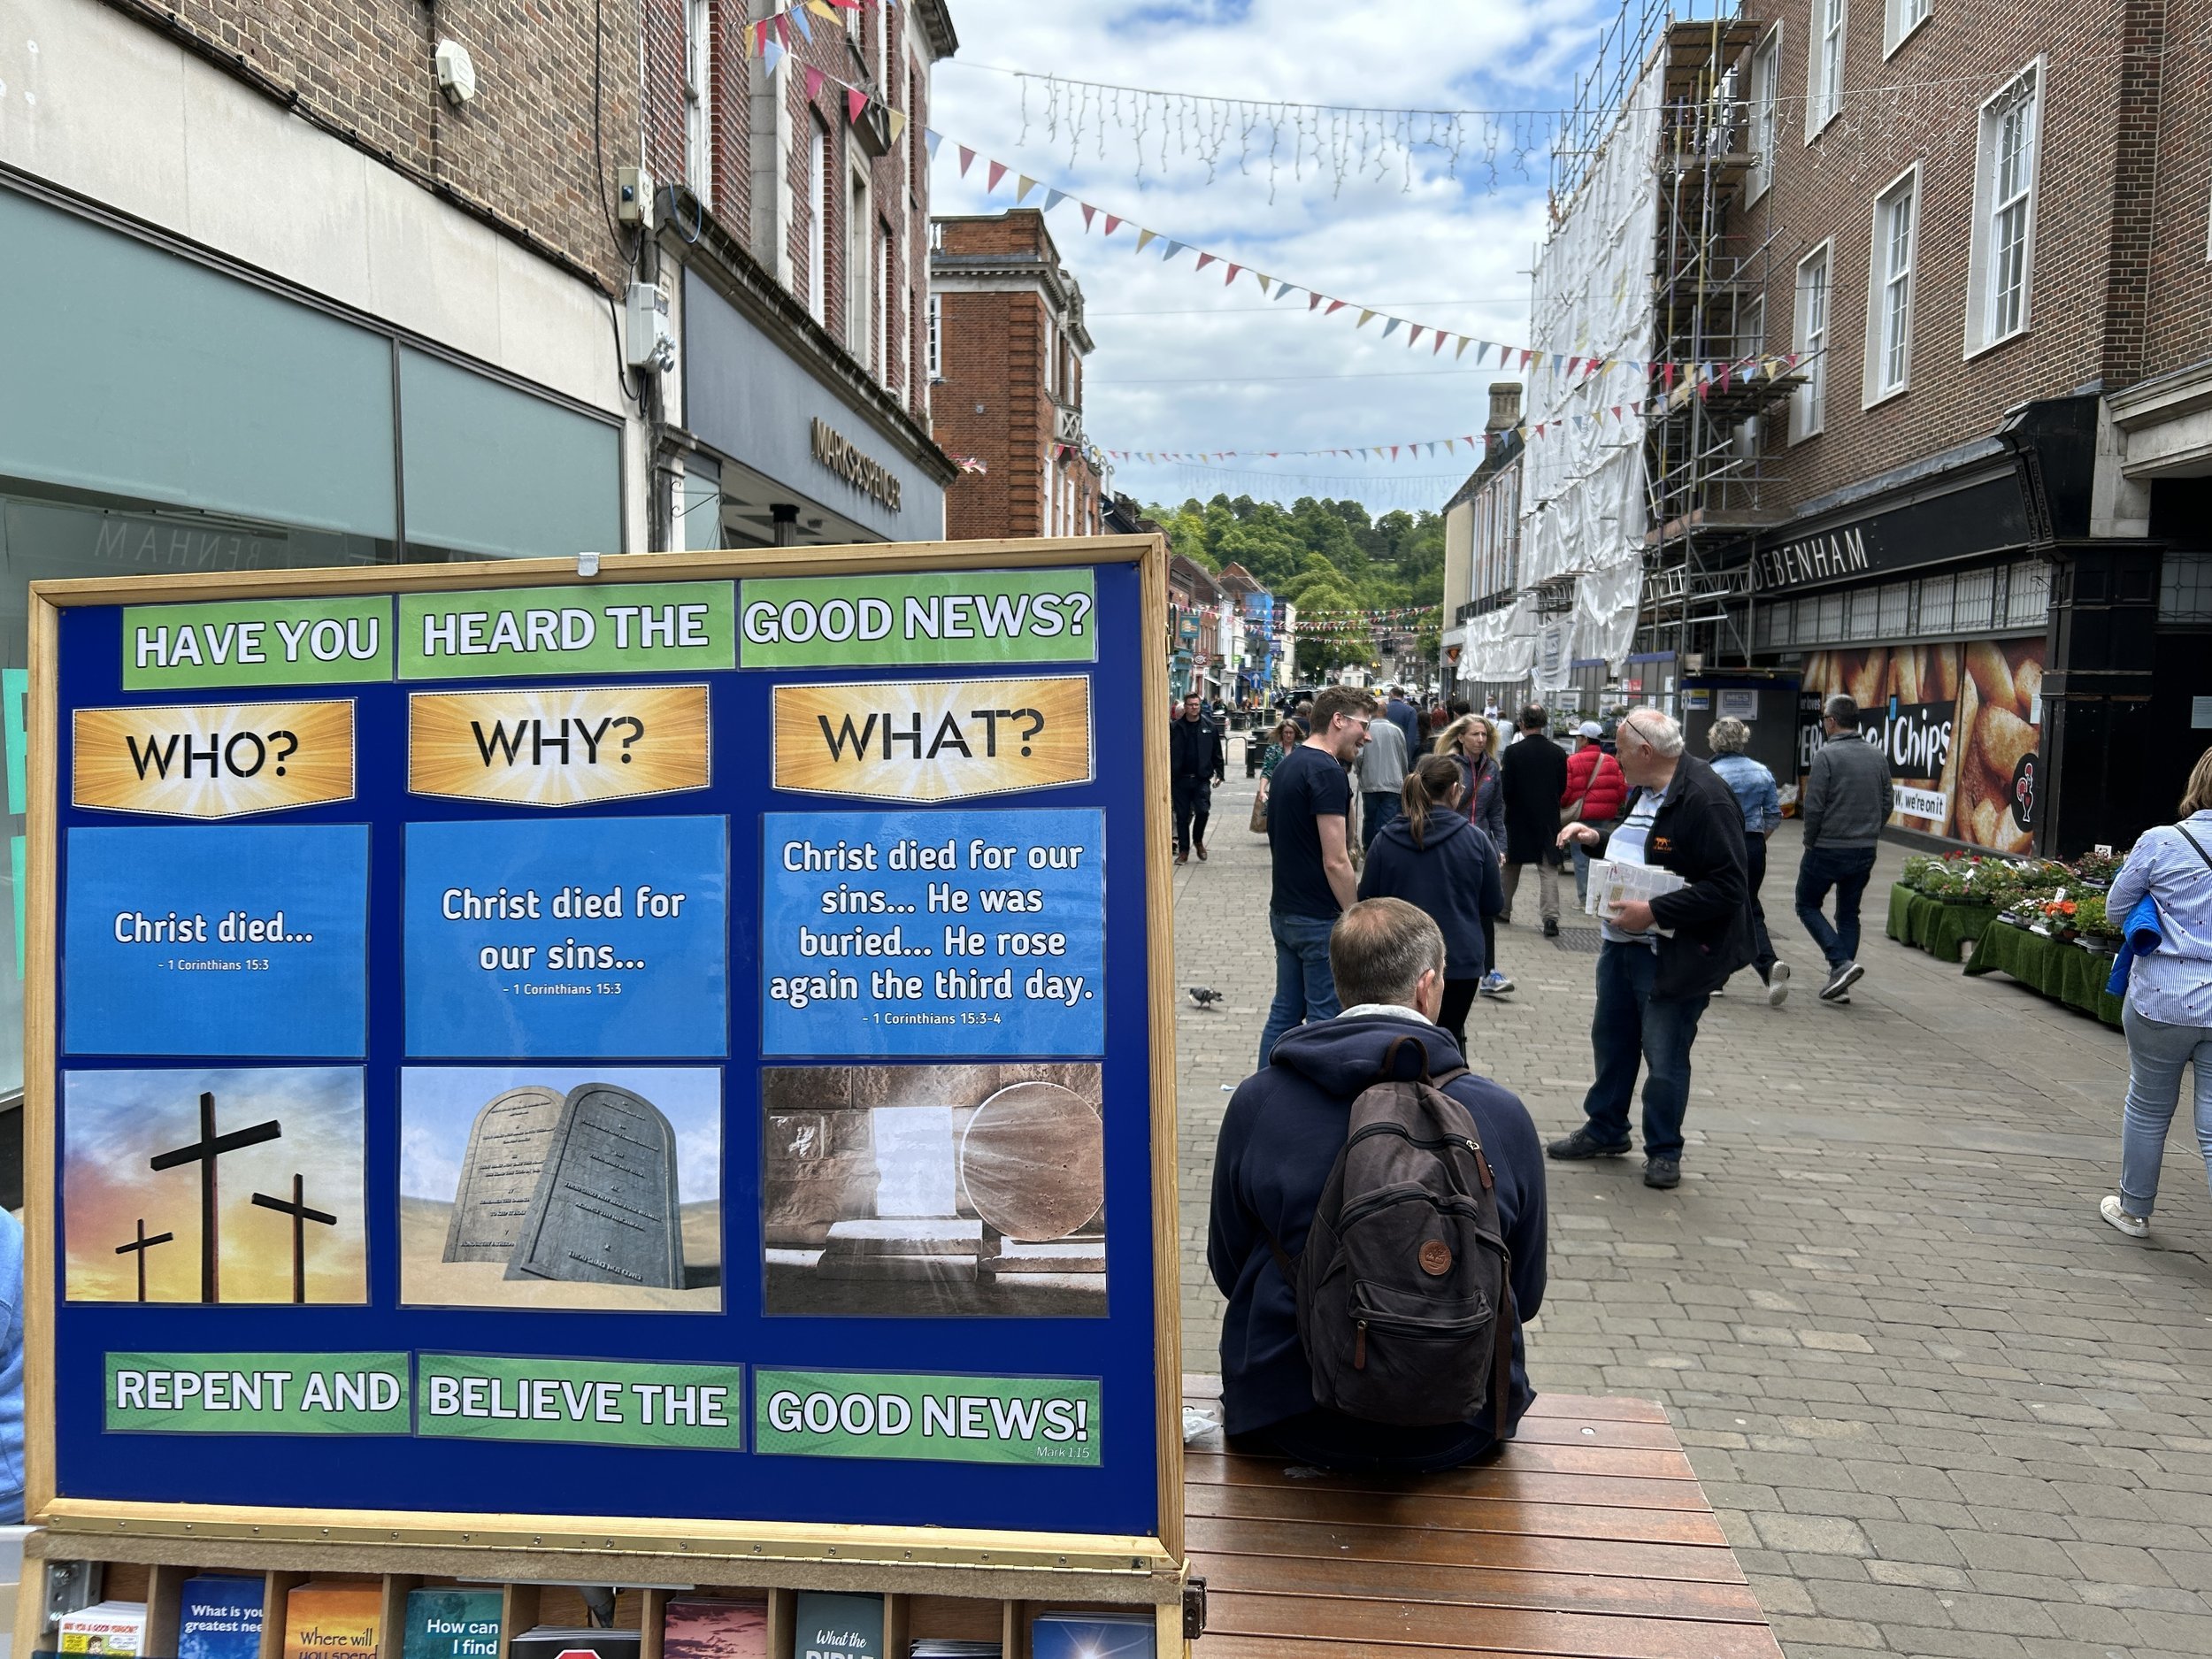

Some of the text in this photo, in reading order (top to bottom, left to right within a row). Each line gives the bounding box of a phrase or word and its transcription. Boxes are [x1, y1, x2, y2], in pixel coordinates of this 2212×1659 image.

[422, 603, 709, 657] HEARD THE
[742, 592, 1092, 644] GOOD NEWS?
[135, 617, 379, 668] HAVE YOU
[471, 715, 644, 768] WHY?
[817, 708, 1045, 763] WHAT?
[1893, 708, 1952, 779] Chips
[126, 729, 299, 781] WHO?
[1905, 793, 1924, 812] we're
[782, 839, 1084, 872] Christ died for our
[442, 887, 687, 921] Christ died for
[820, 883, 1044, 915] sins... He was
[113, 911, 315, 945] Christ died...
[800, 926, 1066, 958] buried... He rose
[167, 959, 174, 972] 1
[177, 958, 242, 972] Corinthians
[245, 958, 269, 972] 15:3
[479, 939, 646, 972] our sins...
[512, 983, 518, 995] 1
[524, 982, 592, 996] Corinthians
[596, 982, 623, 996] 15:3
[769, 970, 1094, 1009] again the third day.
[872, 1012, 879, 1025] 1
[884, 1012, 956, 1025] Corinthians
[960, 1011, 1002, 1025] 15:3-4
[116, 1371, 401, 1413] REPENT AND
[428, 1375, 729, 1428] BELIEVE THE
[767, 1389, 1088, 1442] GOOD NEWS!
[1036, 1446, 1065, 1458] Mark
[185, 1621, 262, 1634] greatest nee
[191, 1604, 264, 1621] What is you
[427, 1618, 499, 1634] How can
[301, 1626, 373, 1647] Where will
[453, 1639, 497, 1655] I find
[816, 1629, 867, 1648] What the
